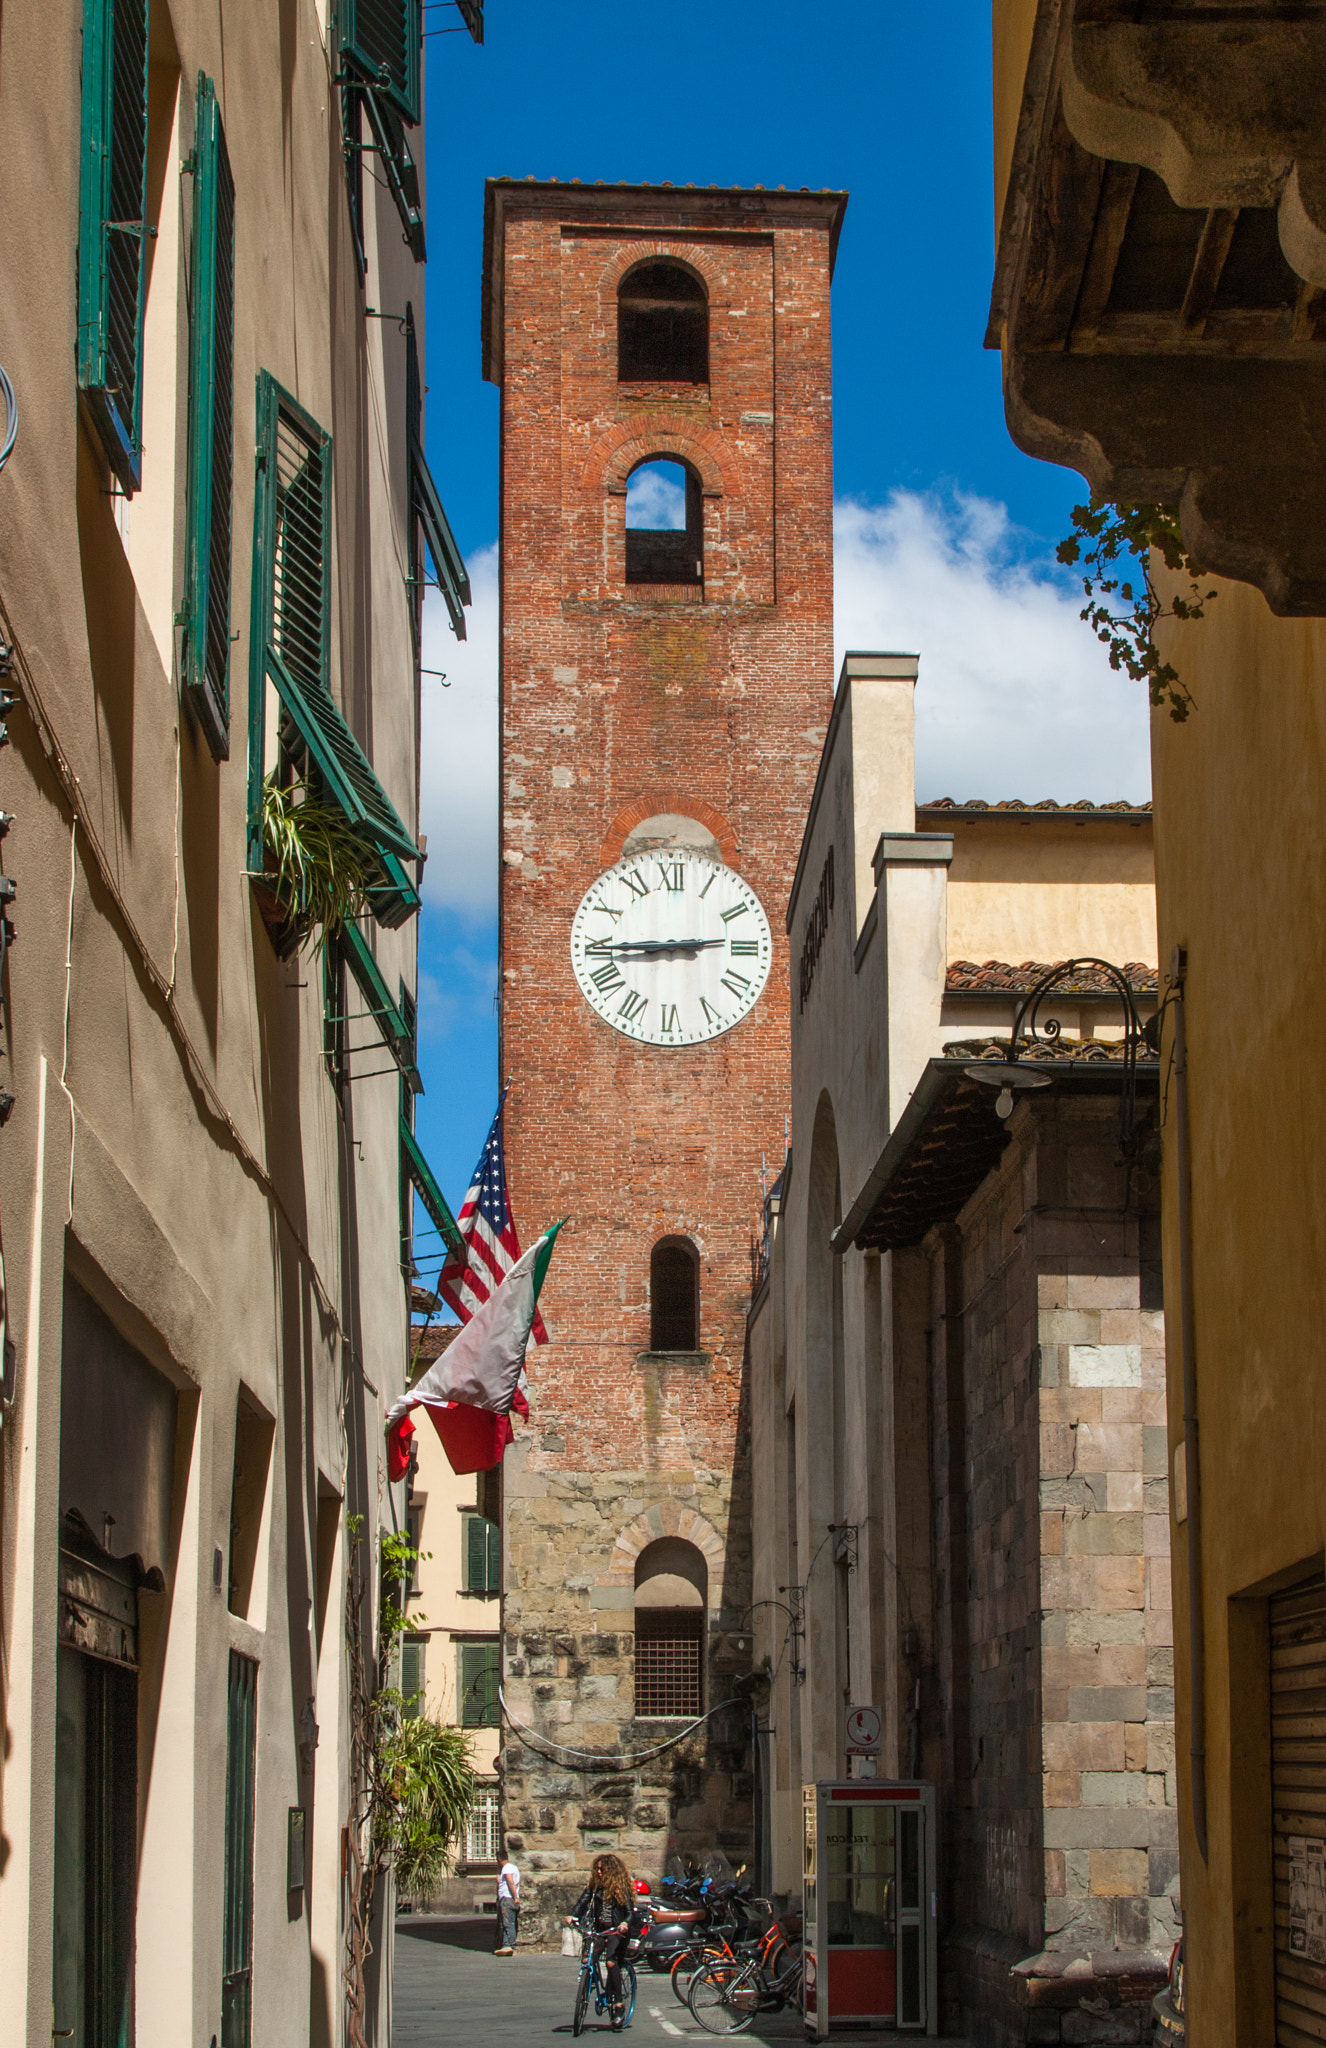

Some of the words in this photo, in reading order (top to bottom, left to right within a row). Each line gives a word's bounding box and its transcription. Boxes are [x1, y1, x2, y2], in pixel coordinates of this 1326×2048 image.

[619, 868, 650, 904] XI
[657, 862, 685, 891] XII
[698, 872, 718, 899] I
[593, 897, 624, 924] X
[720, 901, 749, 924] II
[731, 939, 759, 957] III
[589, 961, 627, 1001] VIII
[720, 968, 751, 1000] IV
[617, 989, 649, 1026] VII
[661, 1003, 683, 1033] VI
[699, 996, 722, 1025] V
